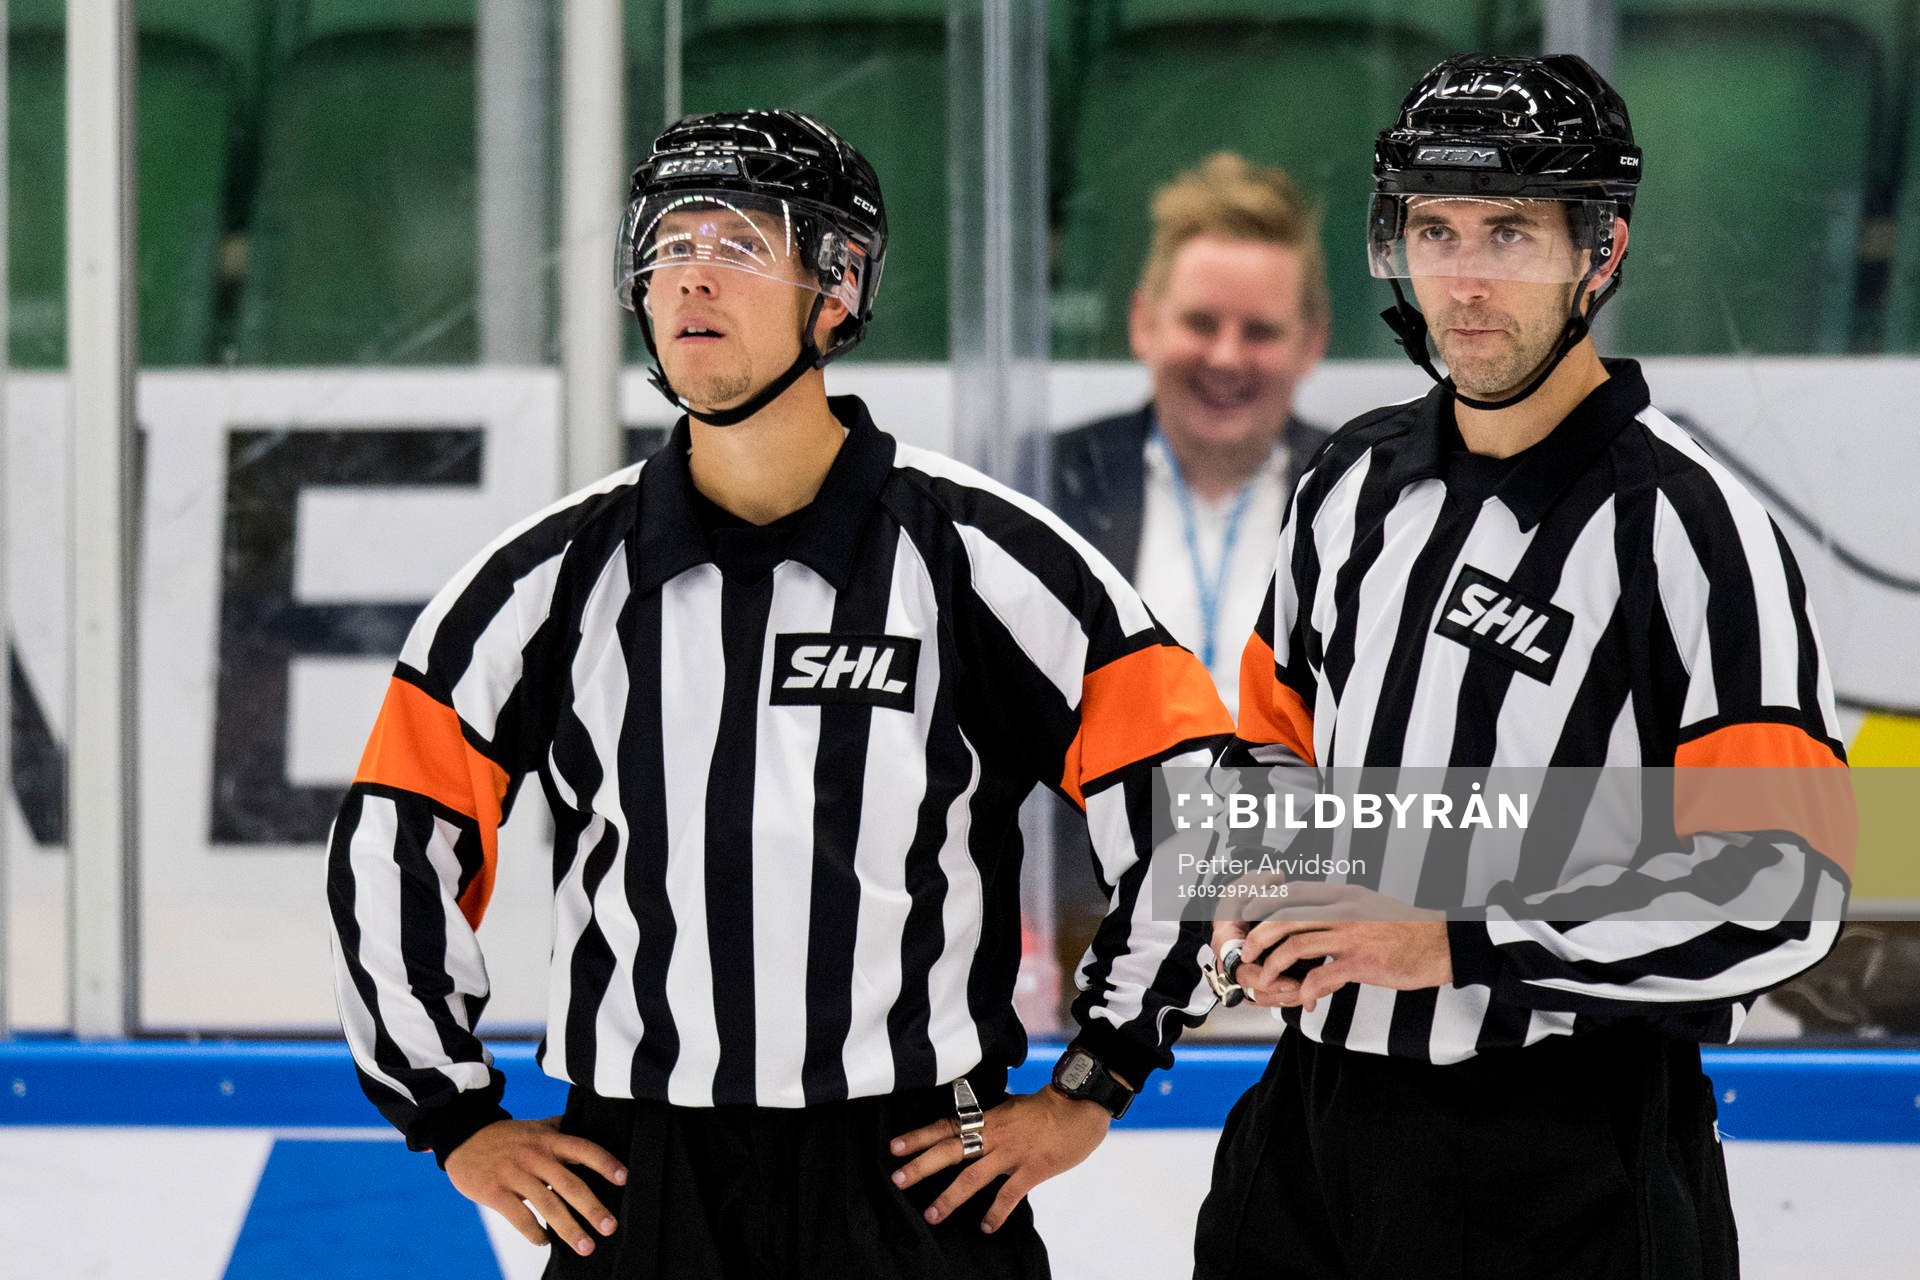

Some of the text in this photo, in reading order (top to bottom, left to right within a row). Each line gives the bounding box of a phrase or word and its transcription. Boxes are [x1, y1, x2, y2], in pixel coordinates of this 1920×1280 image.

[1417, 149, 1495, 162] CCM
[1620, 156, 1639, 166] CCM
[854, 195, 877, 216] CCM
[1446, 583, 1551, 664] SHL
[782, 645, 908, 694] SHL
